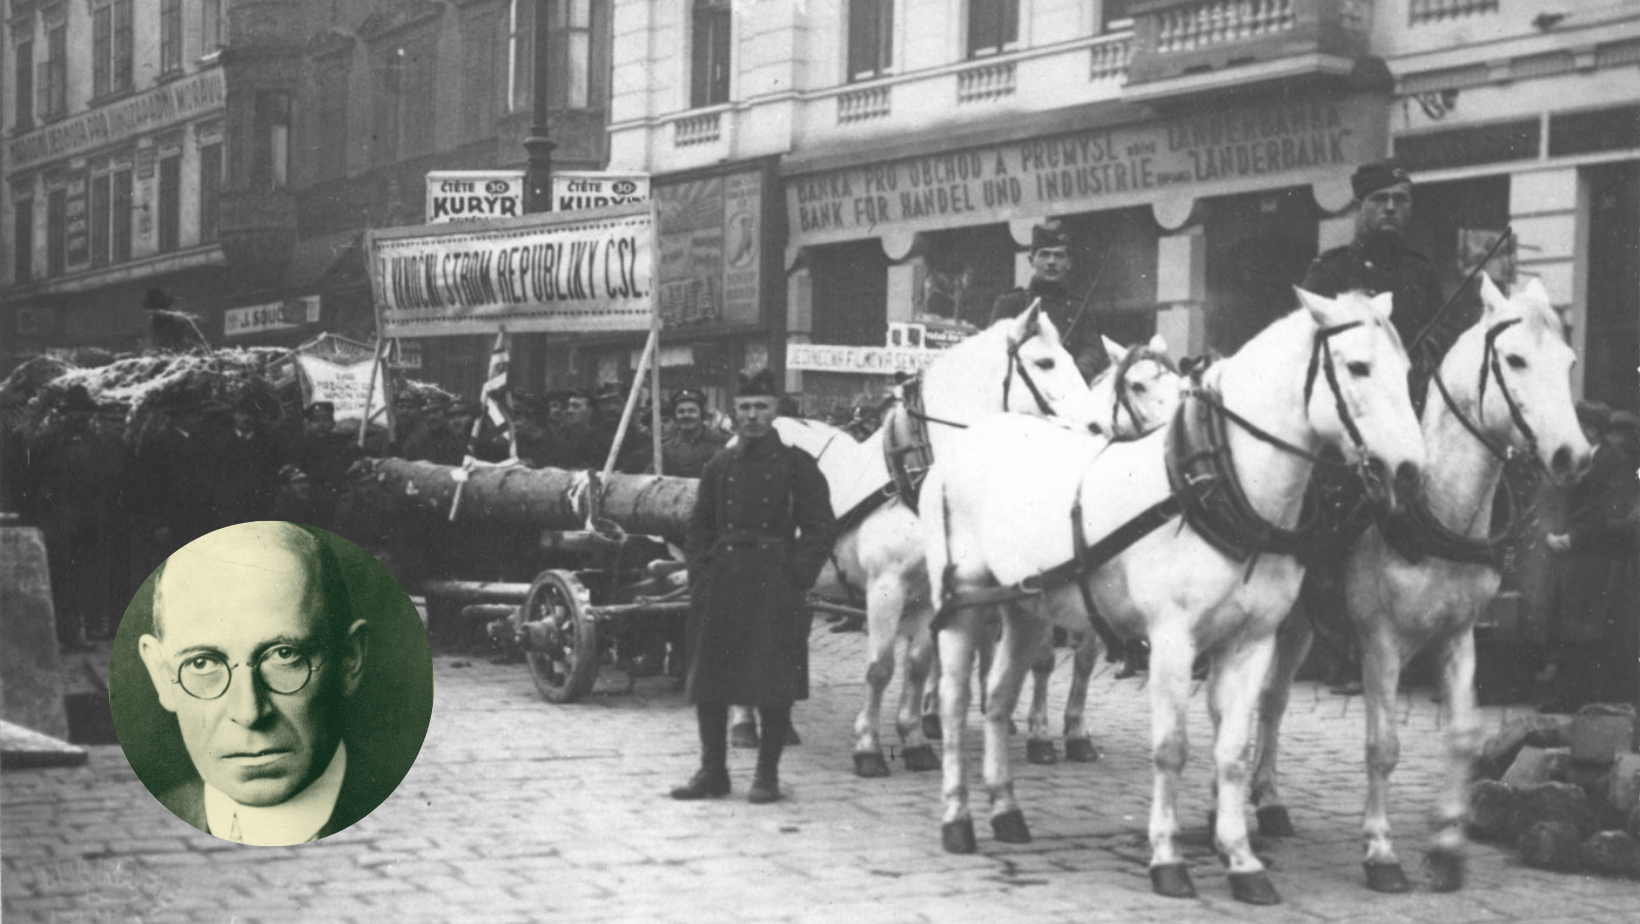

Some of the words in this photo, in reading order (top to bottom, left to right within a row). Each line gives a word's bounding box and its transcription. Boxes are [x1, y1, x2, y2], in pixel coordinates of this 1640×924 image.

[800, 200, 843, 232] BANK
[901, 184, 974, 219] HANDEL
[983, 177, 1022, 208] UND
[1036, 157, 1154, 200] INDUSTRIE
[995, 152, 1008, 176] A
[443, 250, 498, 307] STROM
[498, 241, 599, 306] REPUBLIKY
